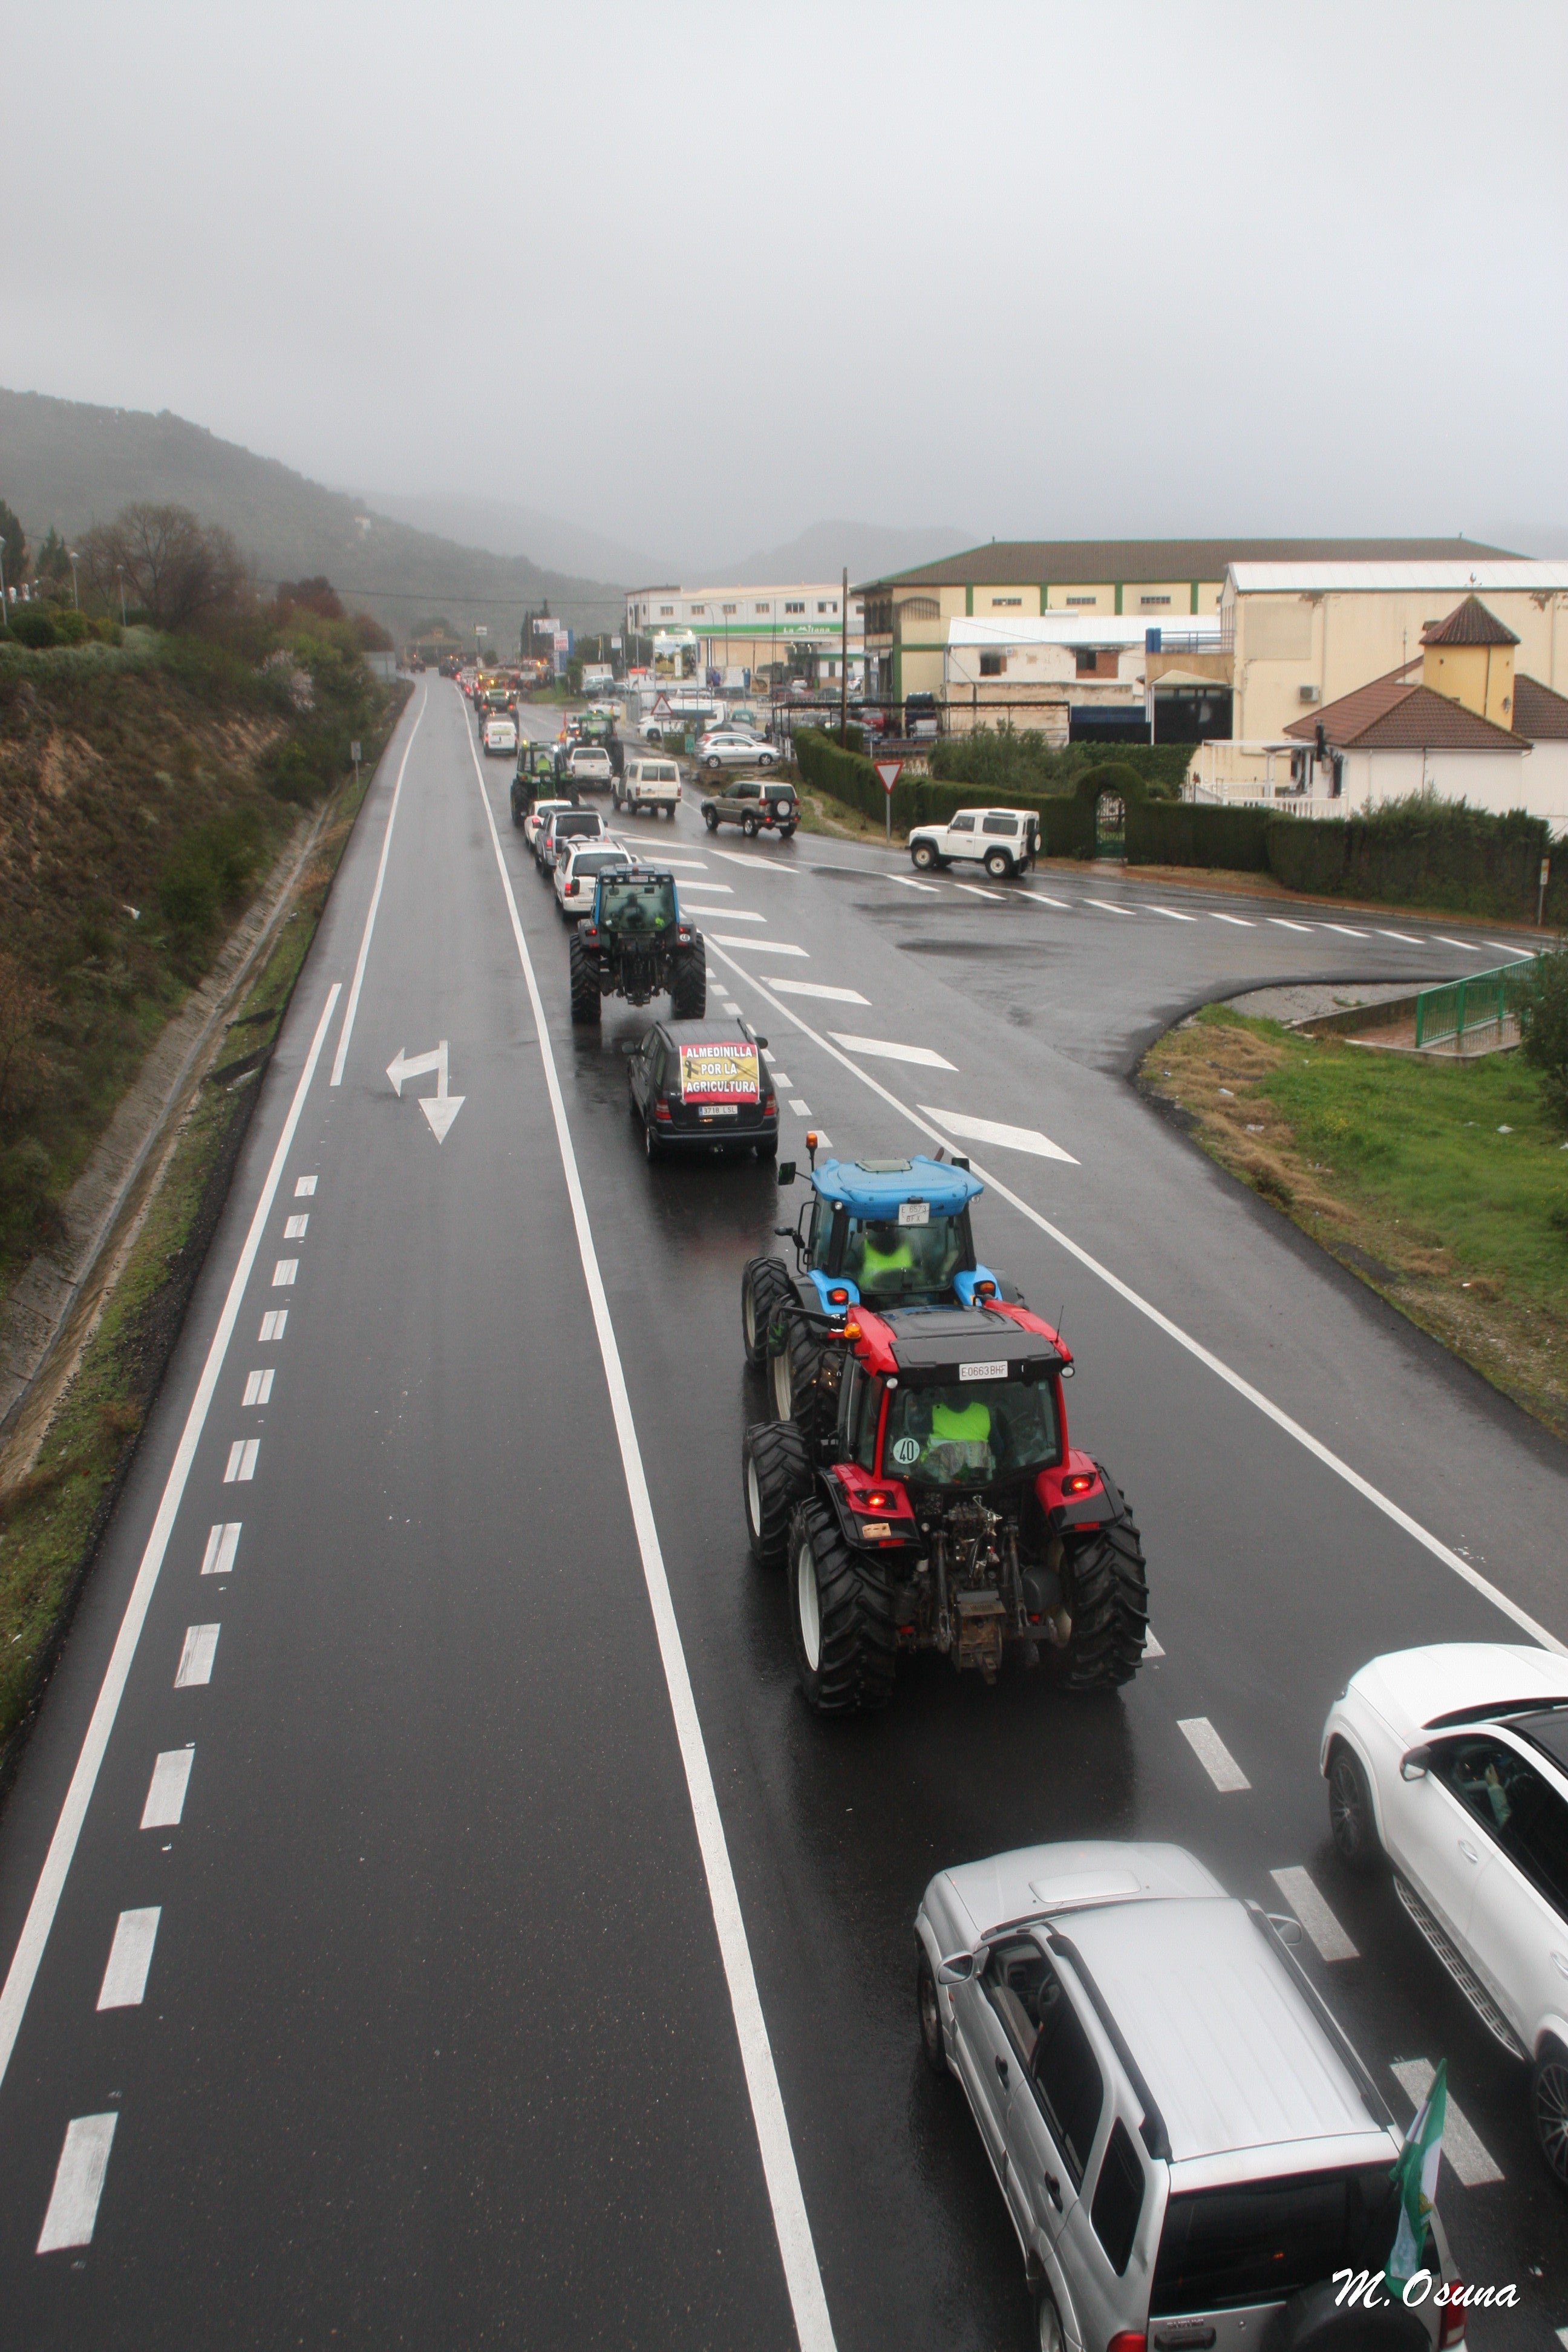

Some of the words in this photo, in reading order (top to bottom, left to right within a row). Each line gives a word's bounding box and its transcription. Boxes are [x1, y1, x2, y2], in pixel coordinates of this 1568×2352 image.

[686, 1047, 753, 1057] ALMEDINILLA
[701, 1063, 721, 1075] POR
[724, 1063, 737, 1074] LA
[686, 1081, 756, 1093] AGRICULTURA
[900, 1440, 914, 1462] 40
